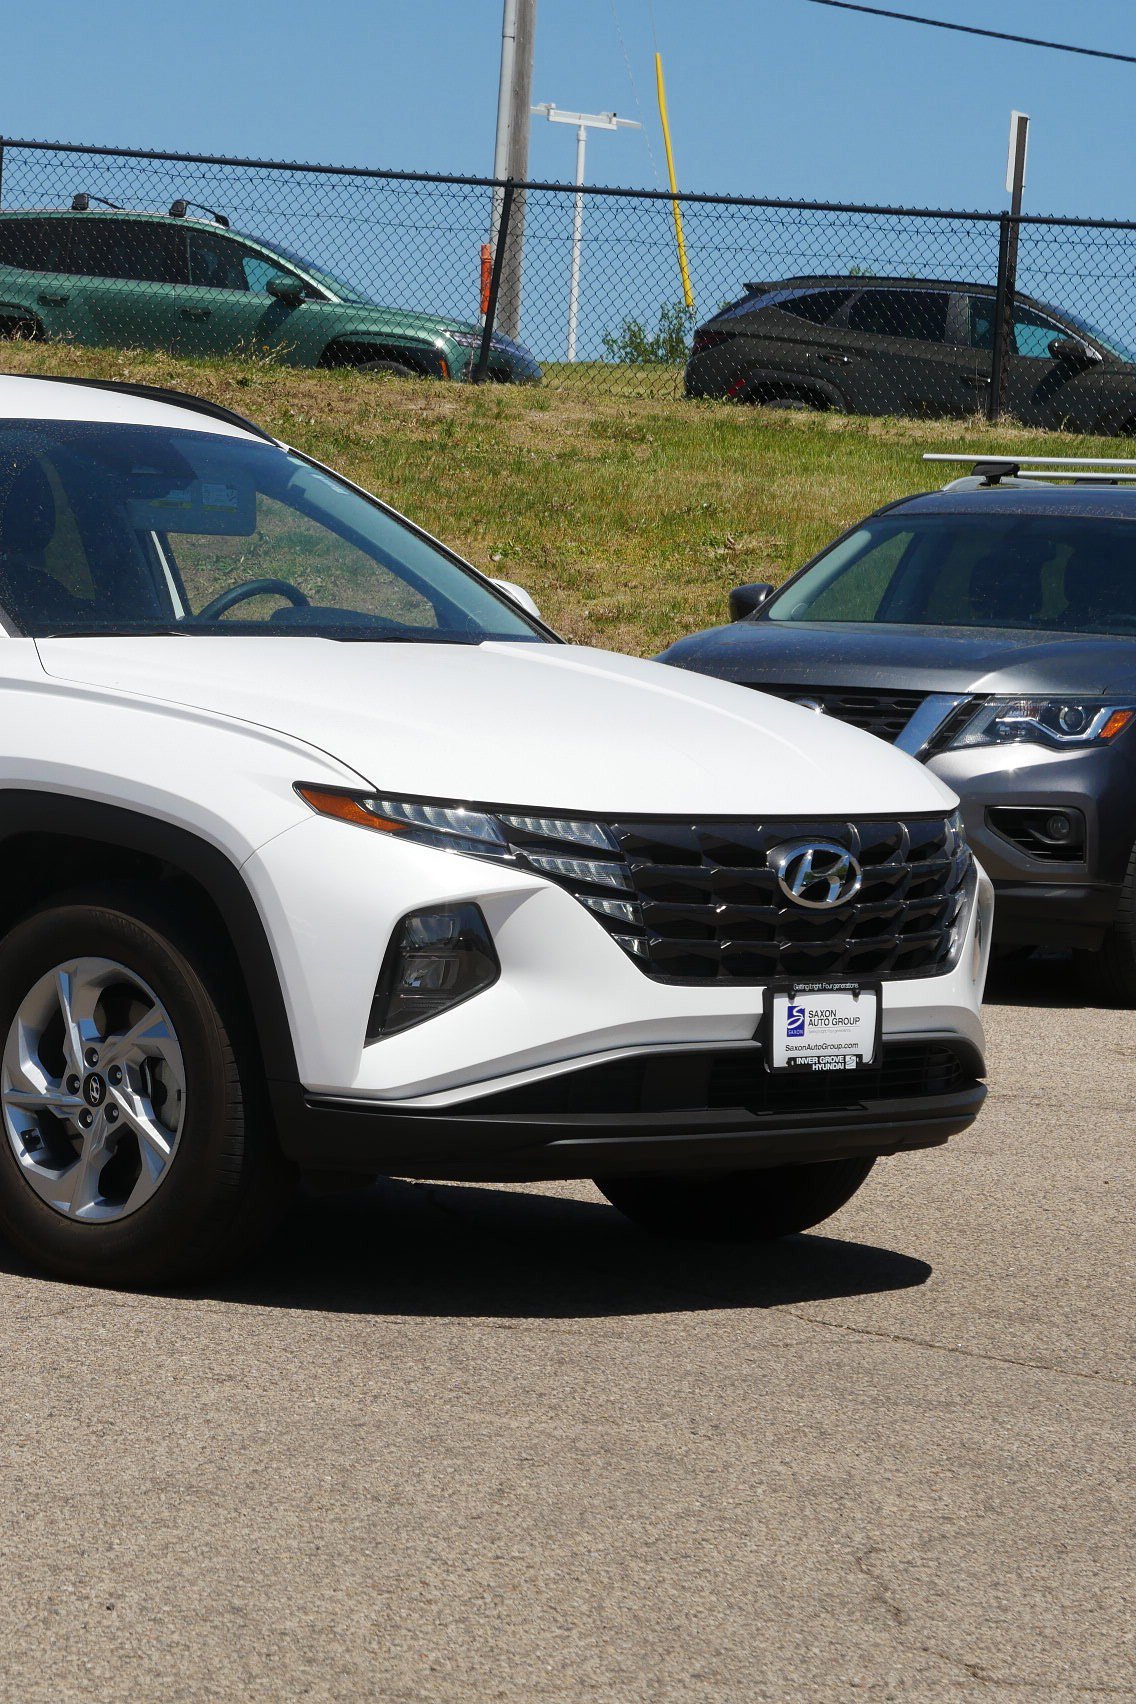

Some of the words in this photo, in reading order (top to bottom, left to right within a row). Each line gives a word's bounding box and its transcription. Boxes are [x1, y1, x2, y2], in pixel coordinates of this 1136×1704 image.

[808, 1009, 837, 1019] SAXON
[808, 1018, 830, 1027] AUTO
[831, 1016, 861, 1026] GROUP
[785, 1042, 859, 1052] SaxonAutoGroup.com
[796, 1056, 818, 1065] INVER
[819, 1055, 845, 1064] GROVE
[812, 1062, 845, 1071] HYUNDAI
